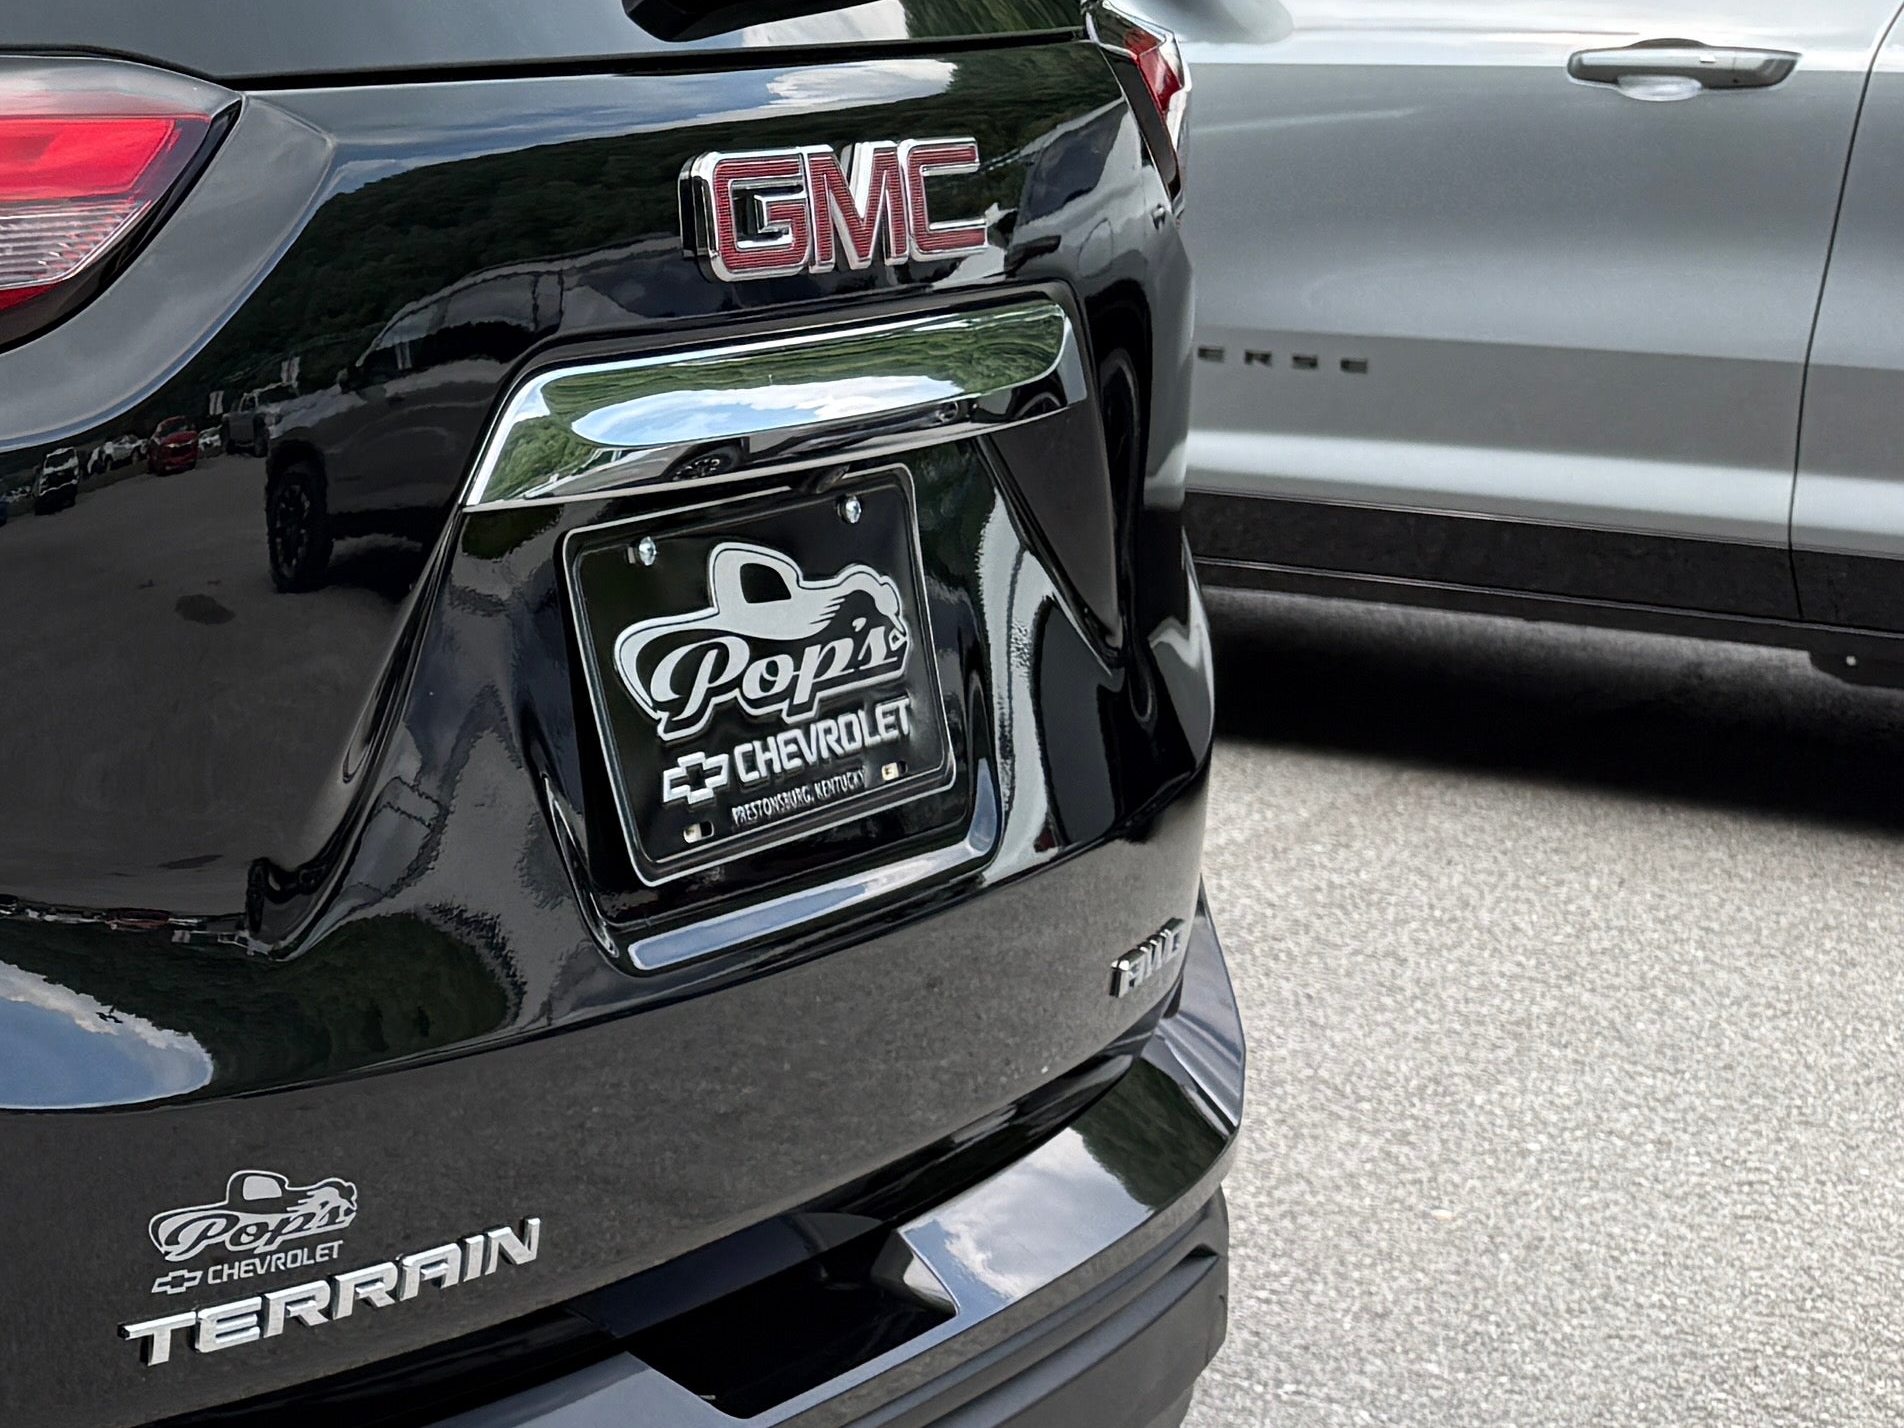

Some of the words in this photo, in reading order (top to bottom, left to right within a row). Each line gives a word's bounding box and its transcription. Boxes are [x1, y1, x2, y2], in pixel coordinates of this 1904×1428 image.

[678, 135, 992, 284] GMC
[649, 616, 899, 721] Pop's
[733, 696, 912, 784] CHEVROLET
[731, 782, 816, 826] PRESTONSBURG,
[814, 765, 868, 801] KENTUCKY
[118, 1216, 541, 1367] TERRAIN
[207, 1239, 344, 1285] CHEVROLET
